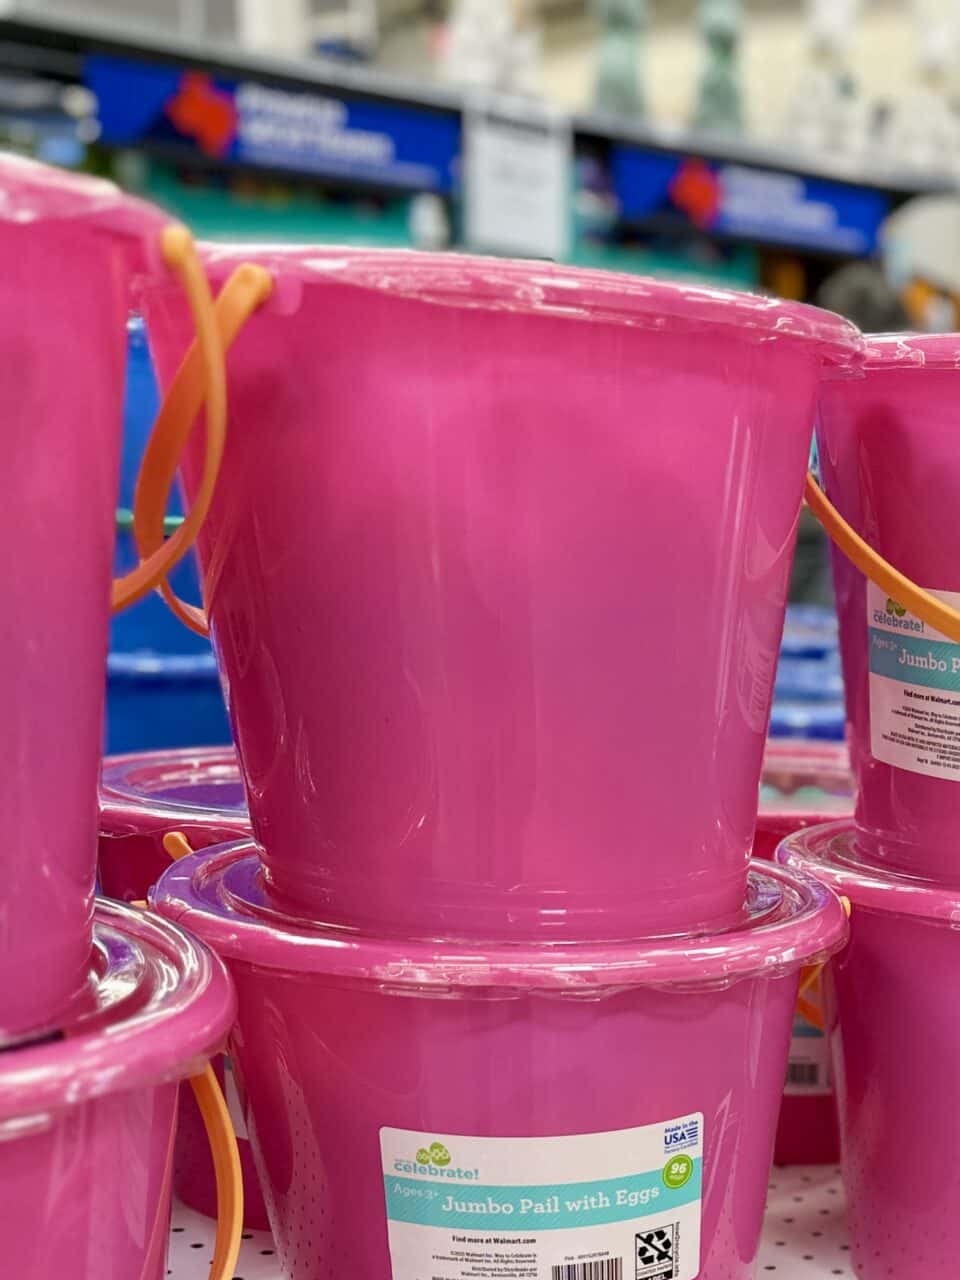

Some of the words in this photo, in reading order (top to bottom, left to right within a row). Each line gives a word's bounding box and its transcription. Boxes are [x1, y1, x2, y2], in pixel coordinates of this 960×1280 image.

[873, 612, 925, 633] celebrate!
[898, 648, 948, 672] Jumbo
[664, 1131, 687, 1145] USA
[393, 1160, 480, 1180] celebrate!
[671, 1162, 688, 1175] 96
[442, 1196, 514, 1215] Jumbo
[519, 1196, 560, 1214] Pail
[565, 1191, 611, 1212] with
[615, 1186, 660, 1207] Eggs
[452, 1235, 466, 1243] Find
[493, 1237, 537, 1245] Walmart.com
